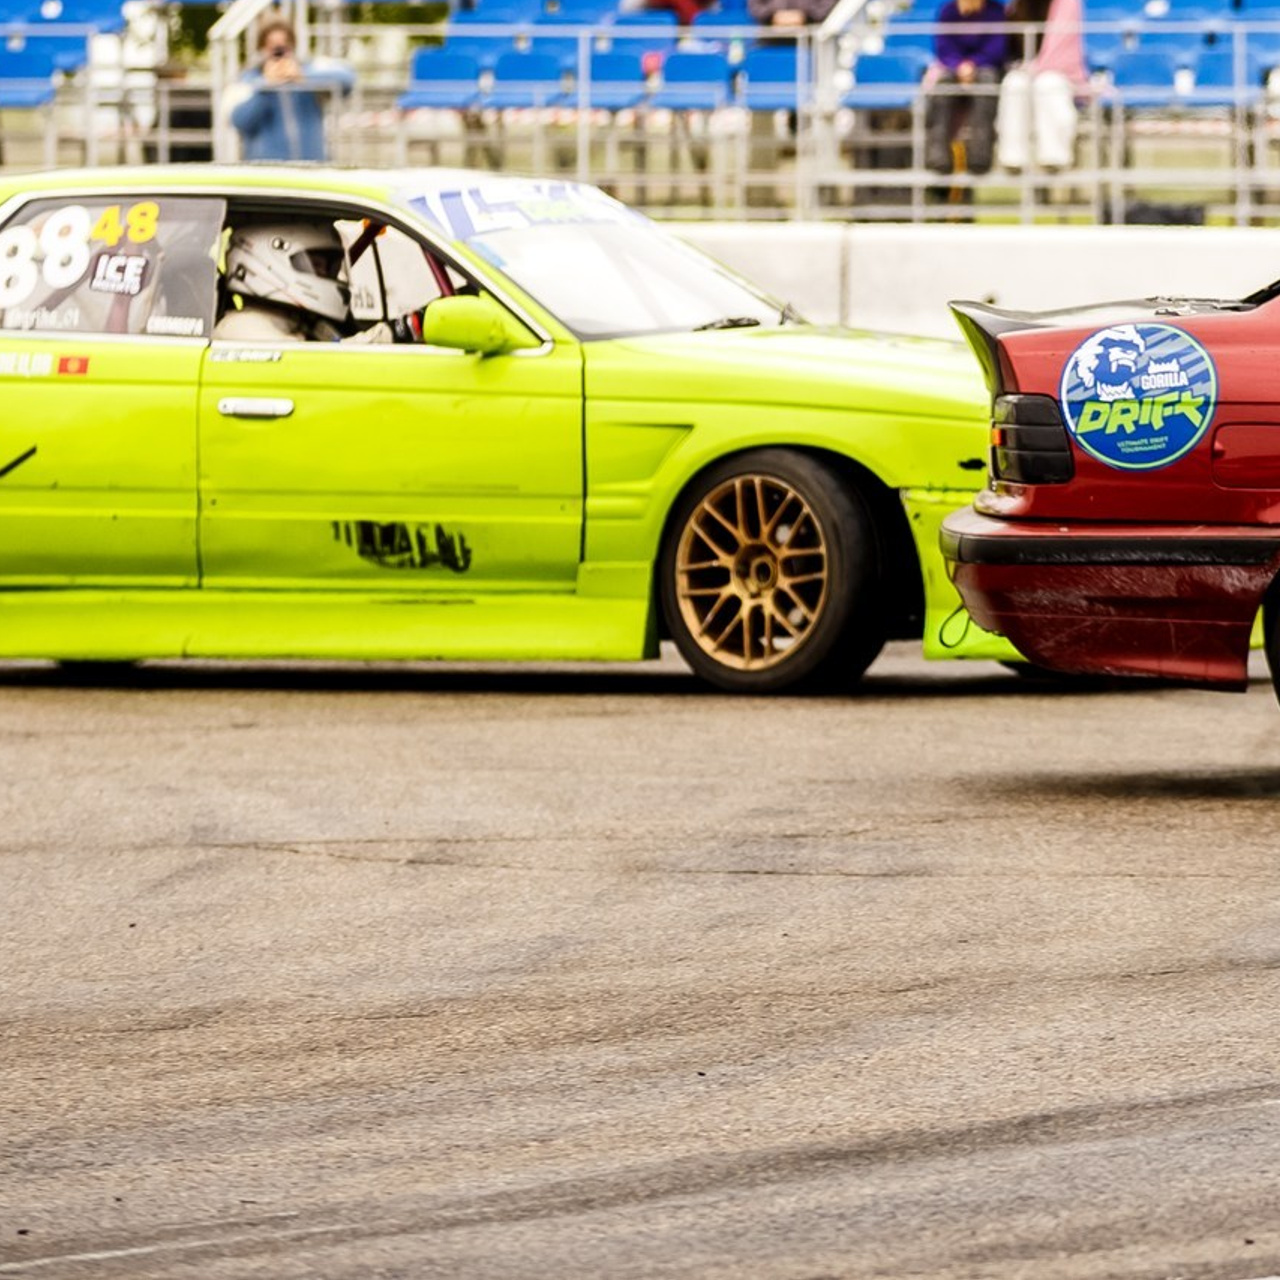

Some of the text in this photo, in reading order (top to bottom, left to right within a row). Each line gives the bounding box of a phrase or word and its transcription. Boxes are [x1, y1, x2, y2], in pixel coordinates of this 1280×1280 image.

[91, 201, 160, 247] 48
[0, 205, 91, 310] 88
[97, 253, 147, 283] ICE
[1141, 371, 1189, 390] GORILLA
[1076, 391, 1205, 434] DRIFT
